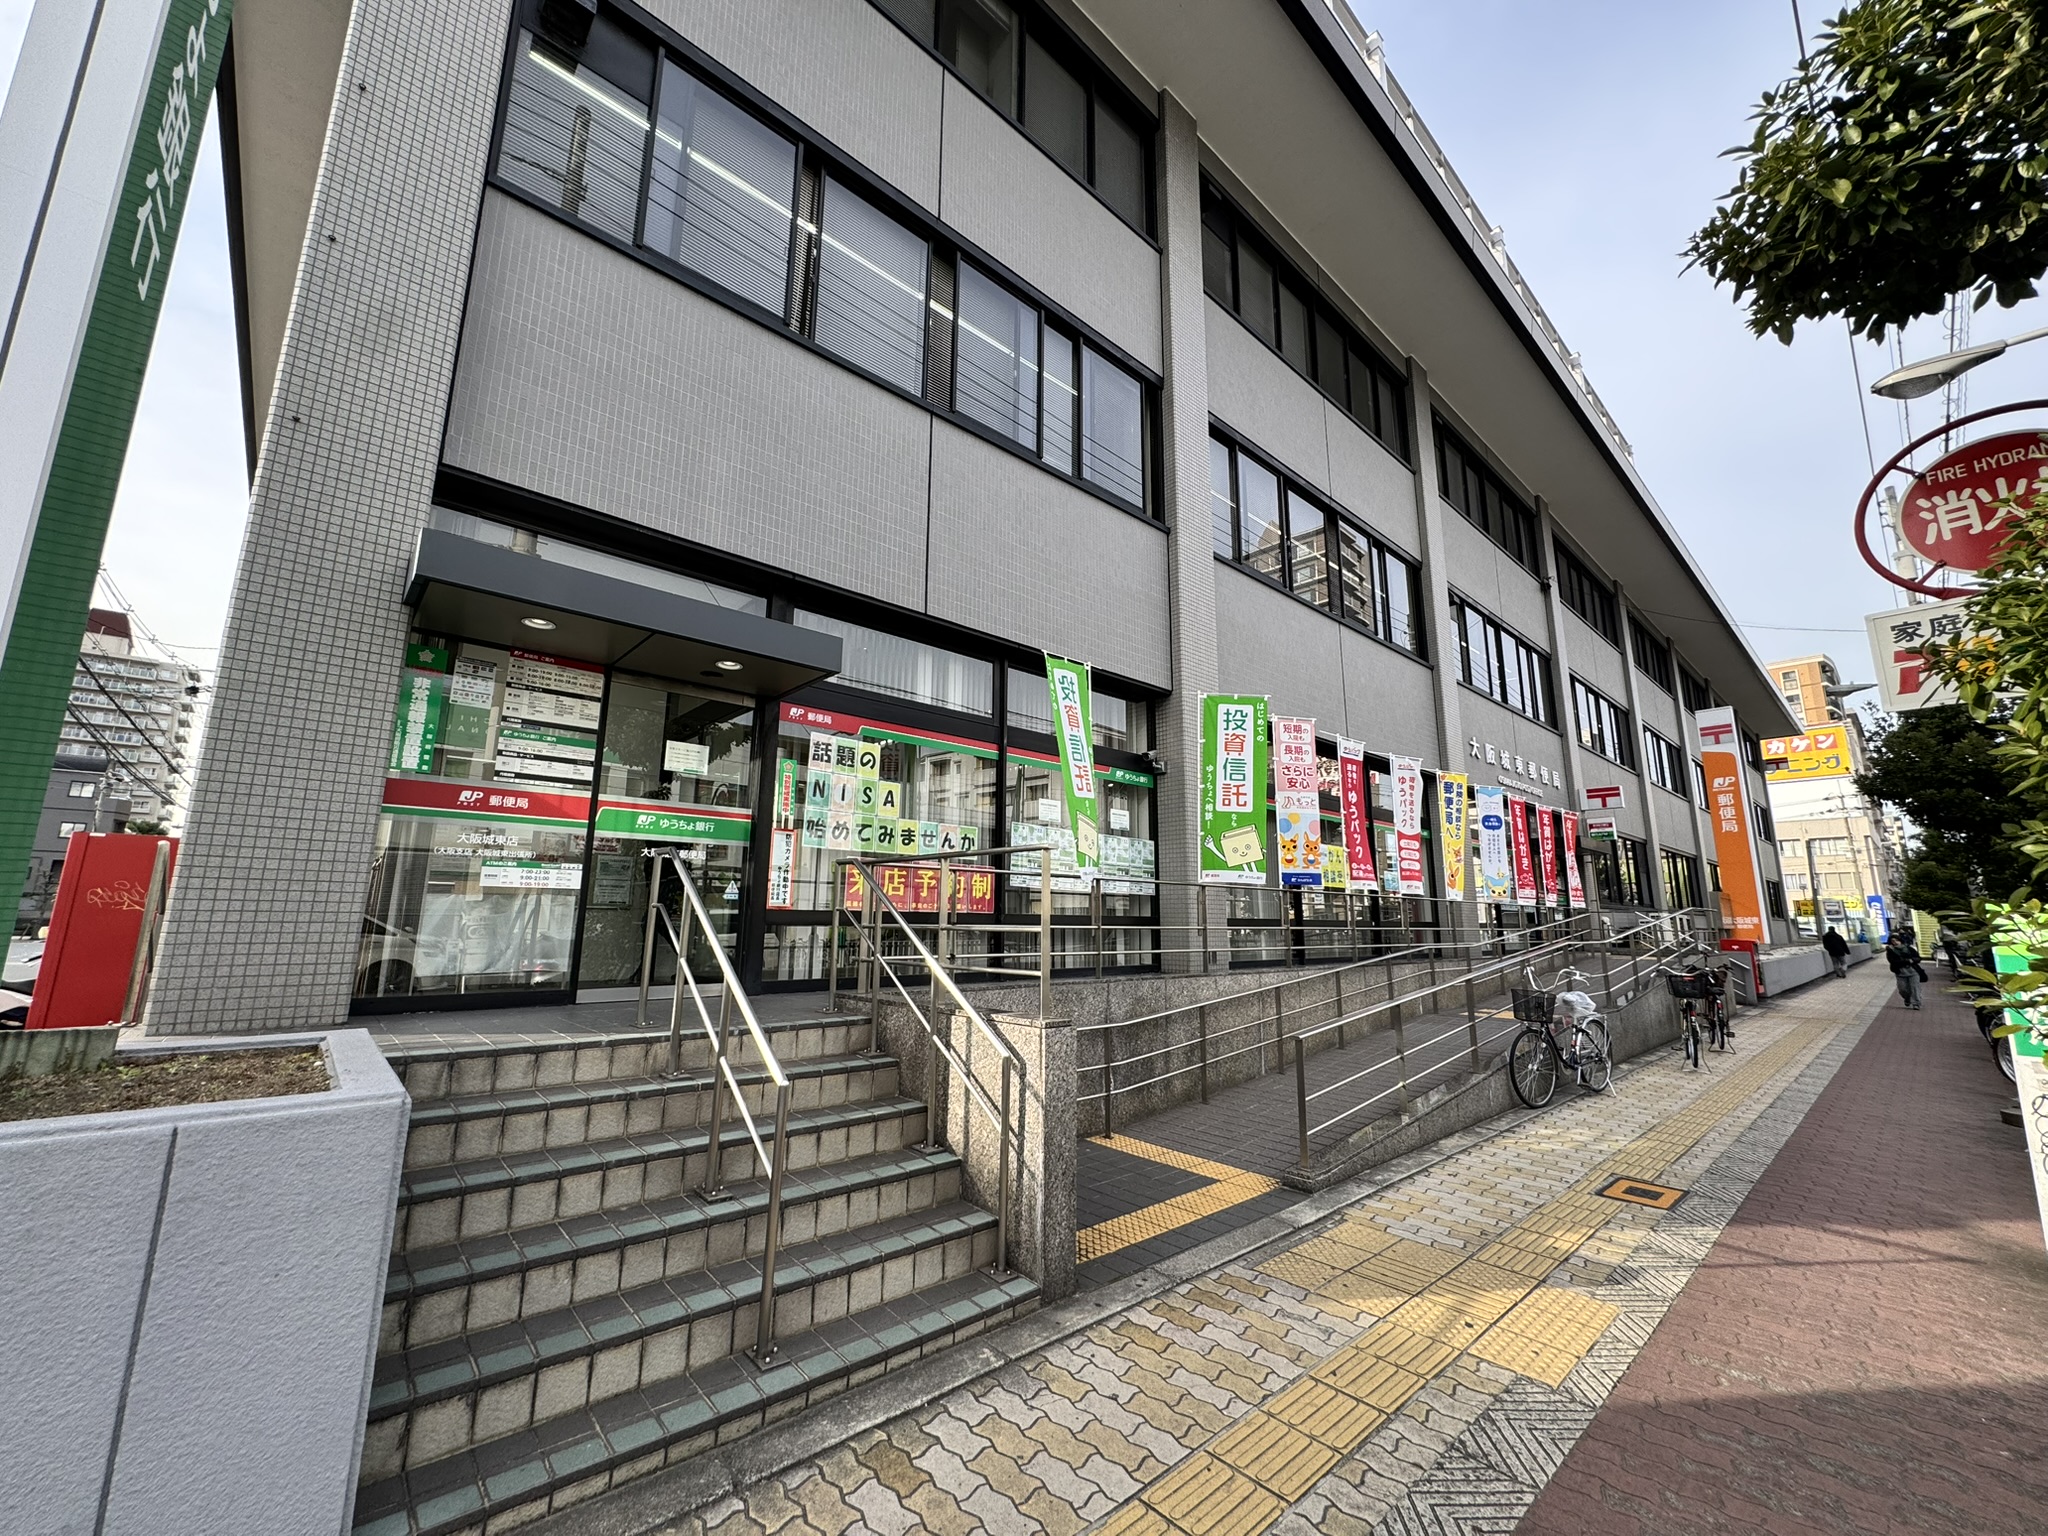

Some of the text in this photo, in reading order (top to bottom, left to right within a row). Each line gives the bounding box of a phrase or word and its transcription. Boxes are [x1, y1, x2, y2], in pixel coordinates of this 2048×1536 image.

[131, 0, 219, 301] ょ銀行
[1925, 466, 1968, 486] FIRE
[1916, 466, 2048, 545] 消火
[807, 712, 833, 725] 郵便局
[1256, 702, 1265, 742] はじめての
[1282, 723, 1309, 735] 短期の
[812, 740, 876, 769] 話題の
[1221, 708, 1248, 808] 投資信託
[1283, 744, 1310, 756] 長期の
[1766, 733, 1836, 755] カケン
[1281, 765, 1314, 777] さらに
[1468, 736, 1561, 789] 大阪城東郵便局
[1766, 753, 1841, 774] ニング
[812, 778, 895, 808] NISA
[1286, 777, 1311, 790] 安心
[1713, 776, 1736, 788] JP
[488, 795, 529, 809] 郵便局
[1397, 776, 1407, 828] ゆうパック
[1408, 776, 1416, 830] 荷物を送るなら
[1443, 781, 1455, 839] 郵便局へ
[1717, 793, 1738, 833] 郵便局
[659, 818, 715, 833] ゆうちょ銀行
[806, 817, 975, 851] 始めてみませんか
[1231, 813, 1238, 828] なら
[1347, 790, 1363, 859] ゆうパック
[457, 833, 519, 847] 大阪城東店
[1514, 803, 1529, 871] 年賀はがき
[782, 833, 792, 905] 防犯カメラ作動中です
